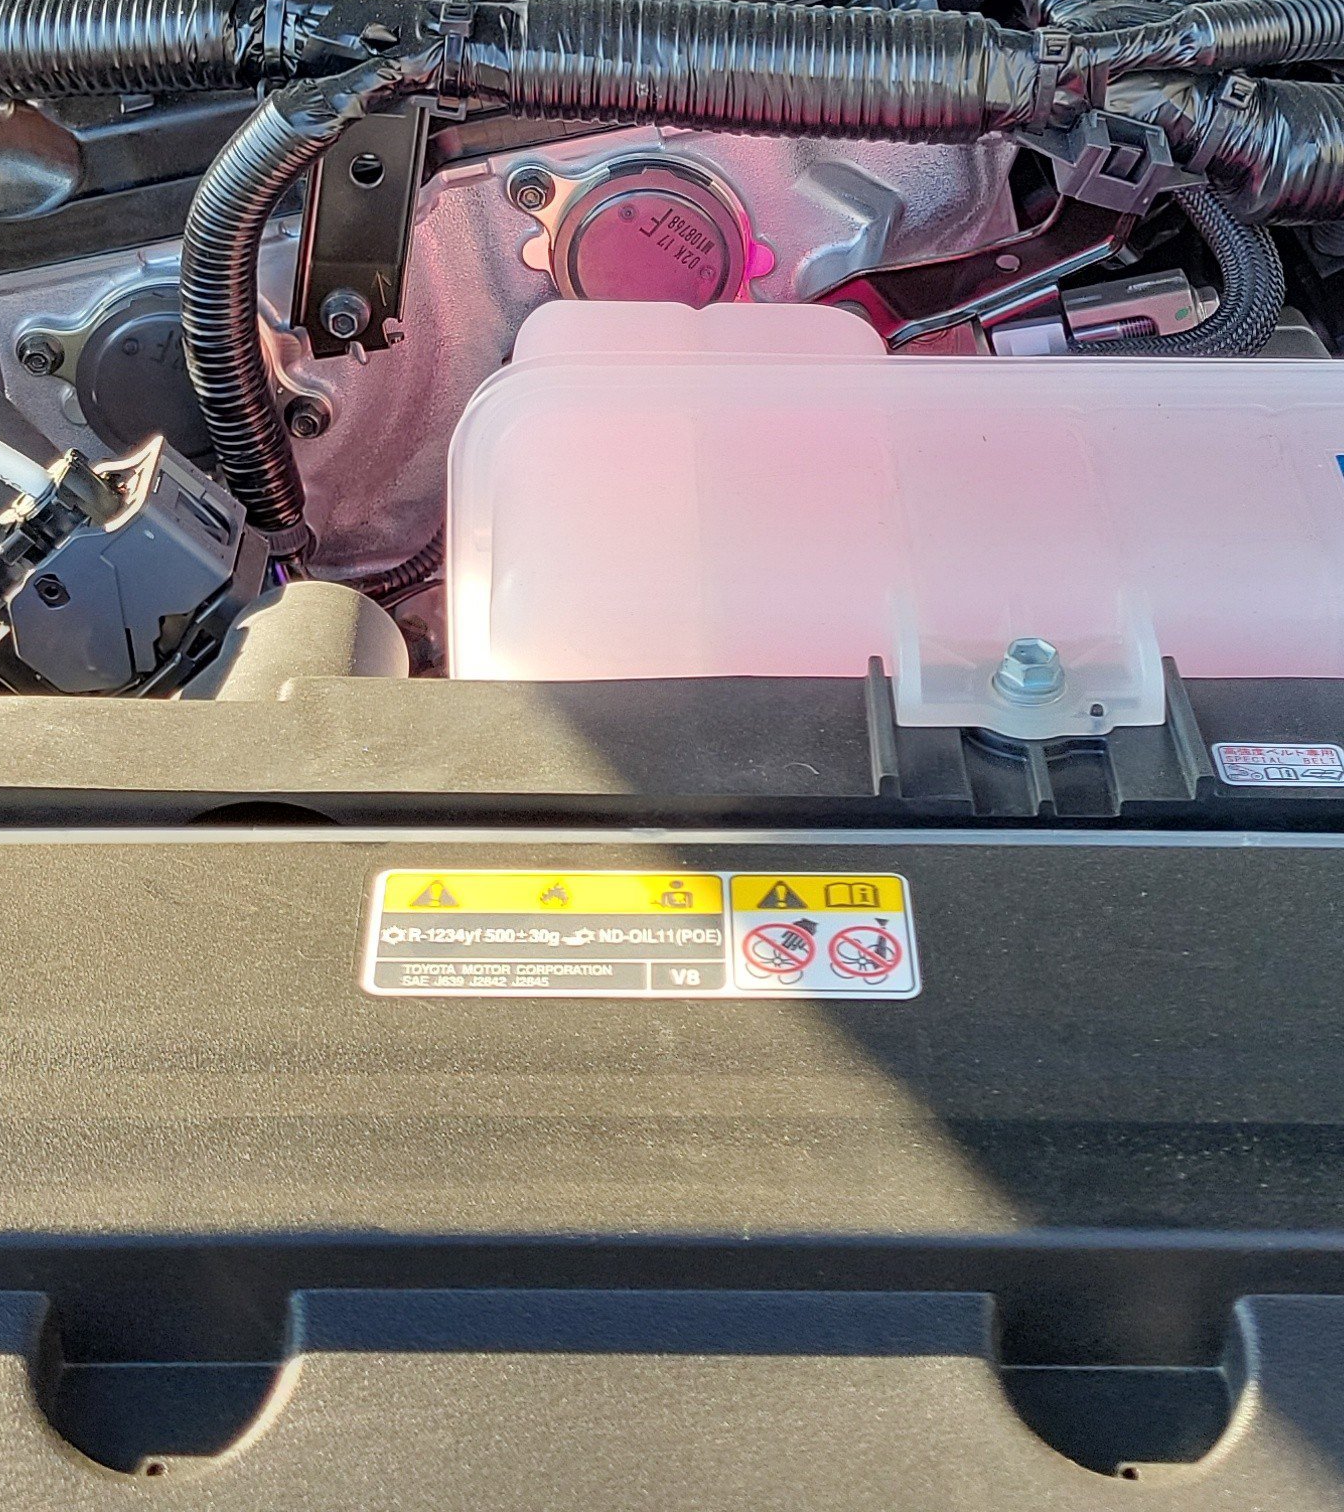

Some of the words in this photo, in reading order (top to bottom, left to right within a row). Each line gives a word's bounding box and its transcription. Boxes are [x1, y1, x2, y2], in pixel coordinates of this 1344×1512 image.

[1225, 755, 1284, 764] SPECIAL
[1302, 757, 1336, 765] BELT
[407, 928, 483, 946] R-1234yf
[598, 928, 723, 947] ND-OIL11(POE)
[403, 964, 457, 975] TOYOTA
[461, 964, 511, 975] MOTOR
[516, 964, 614, 976] CORPORATION
[401, 975, 431, 987] SAE
